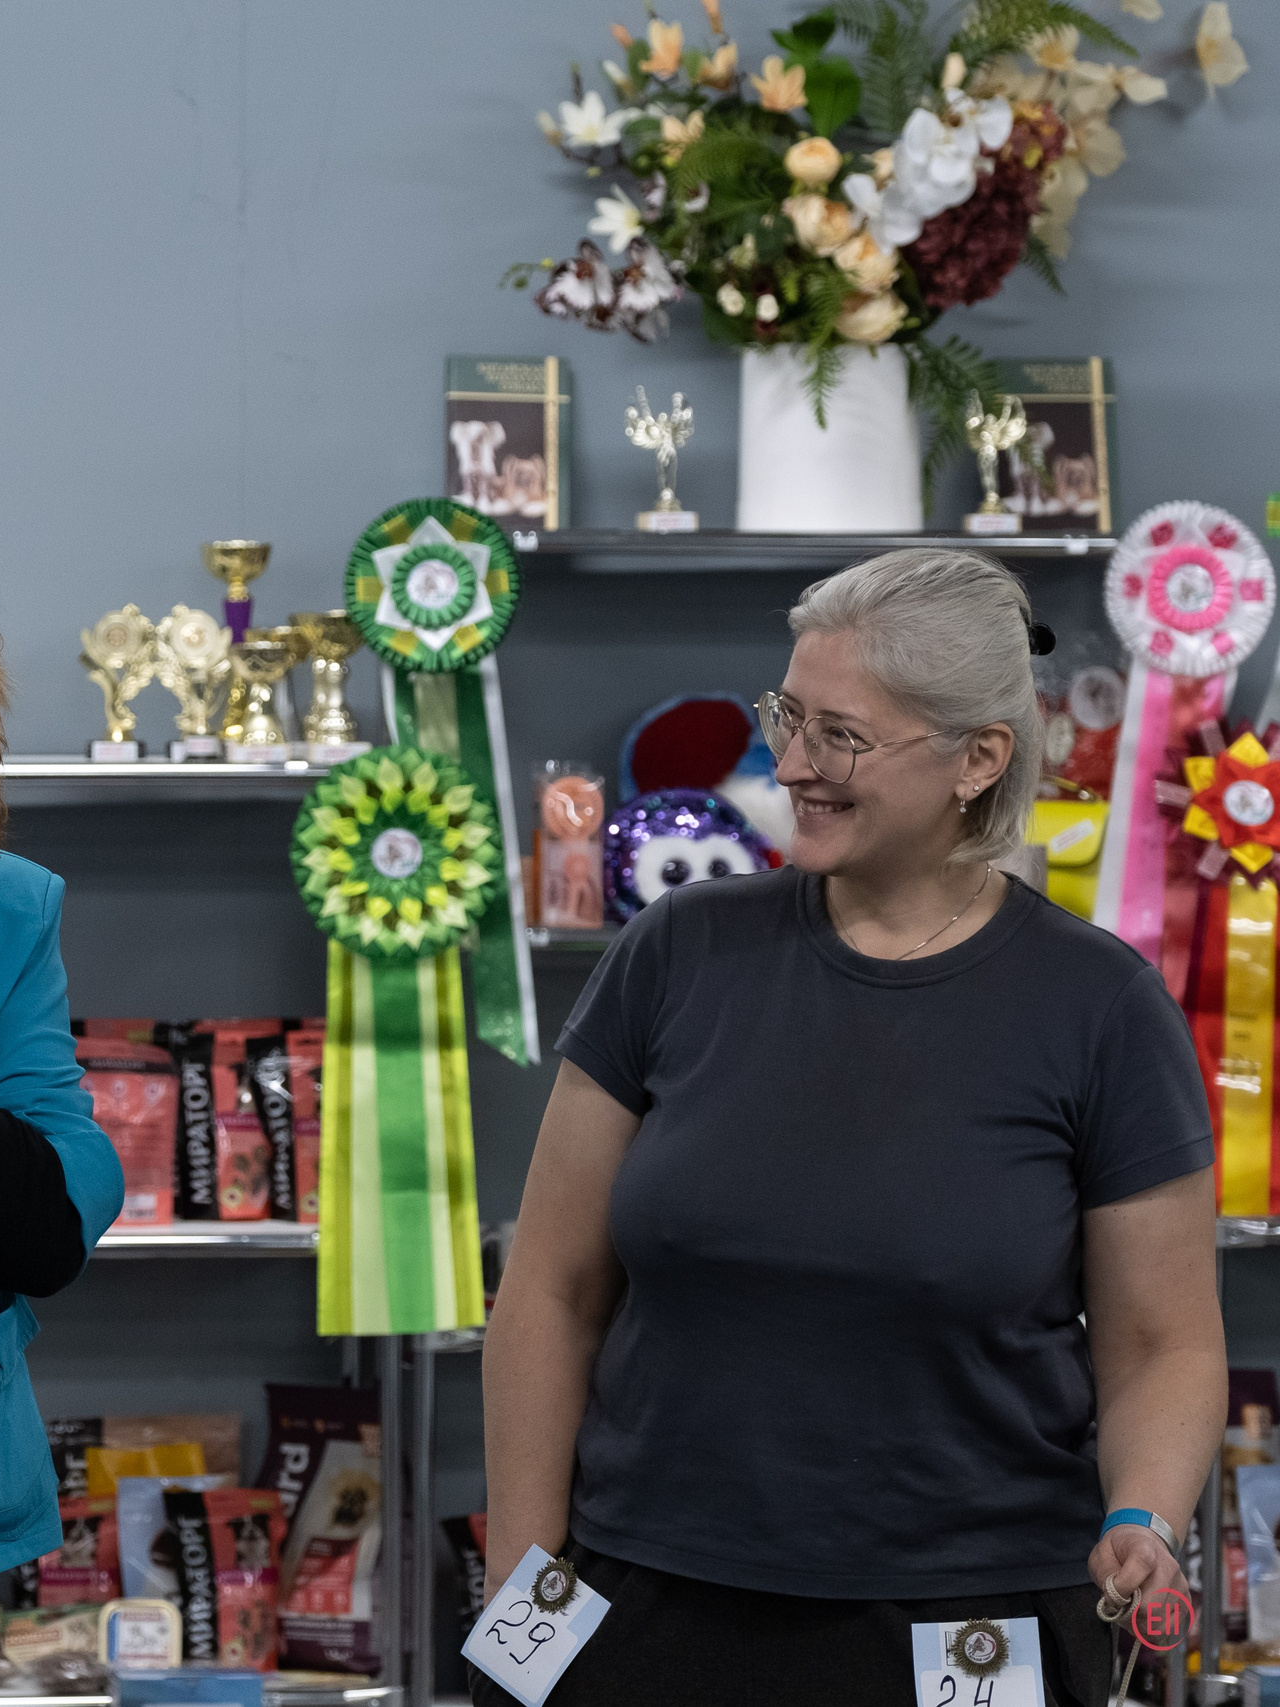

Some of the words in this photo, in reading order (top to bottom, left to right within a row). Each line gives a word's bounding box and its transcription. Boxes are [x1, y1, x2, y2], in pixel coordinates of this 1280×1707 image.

[182, 1058, 213, 1205] МИРАТОРГ
[177, 1516, 214, 1659] МИРАТОРГ
[485, 1600, 556, 1665] 29
